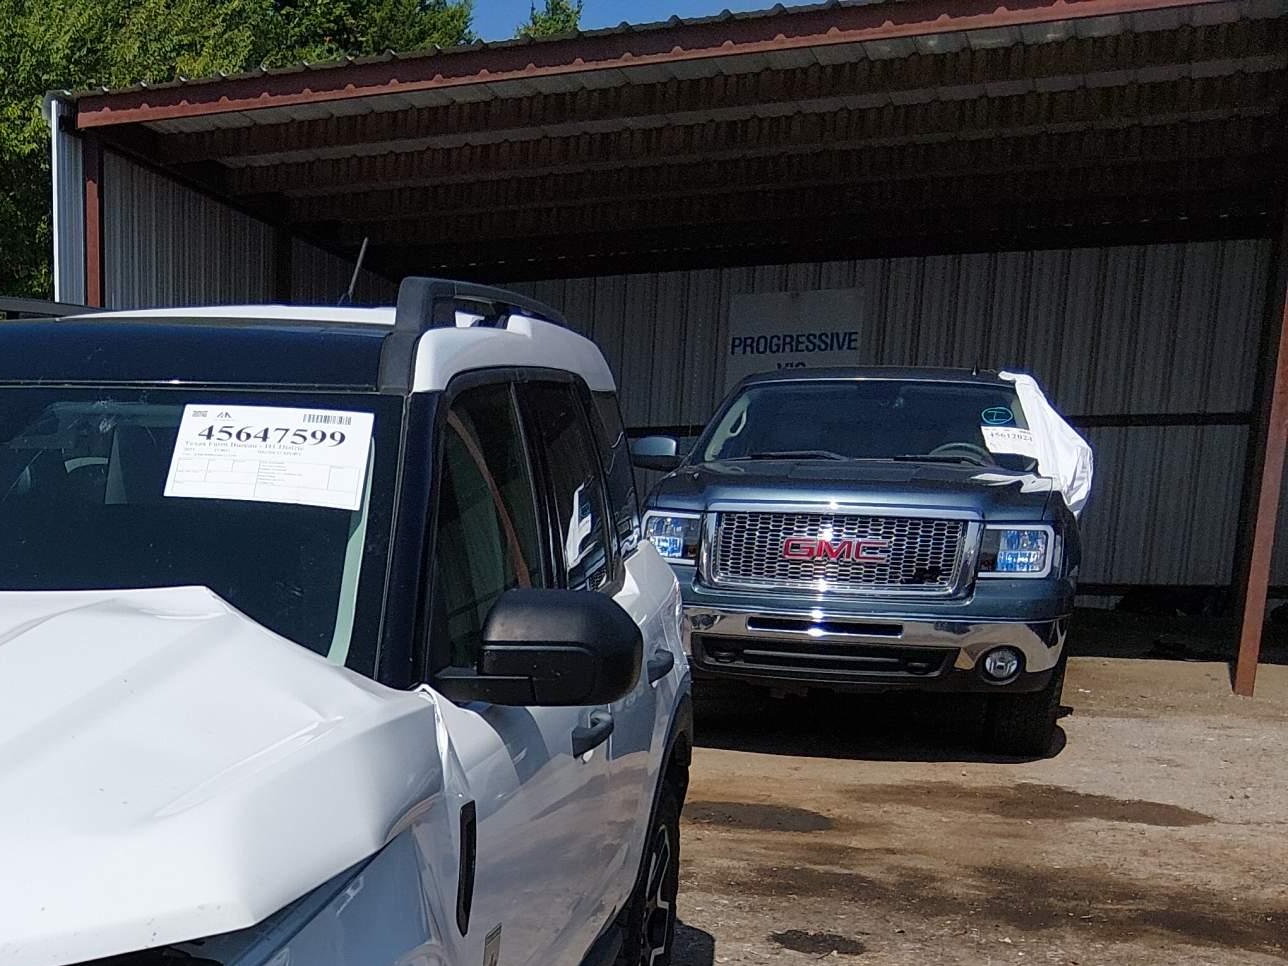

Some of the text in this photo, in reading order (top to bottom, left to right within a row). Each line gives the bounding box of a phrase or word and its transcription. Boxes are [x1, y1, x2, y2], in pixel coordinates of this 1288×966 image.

[730, 331, 859, 355] PROGRESSIVE
[197, 424, 346, 447] 45647599
[782, 537, 890, 563] GMC
